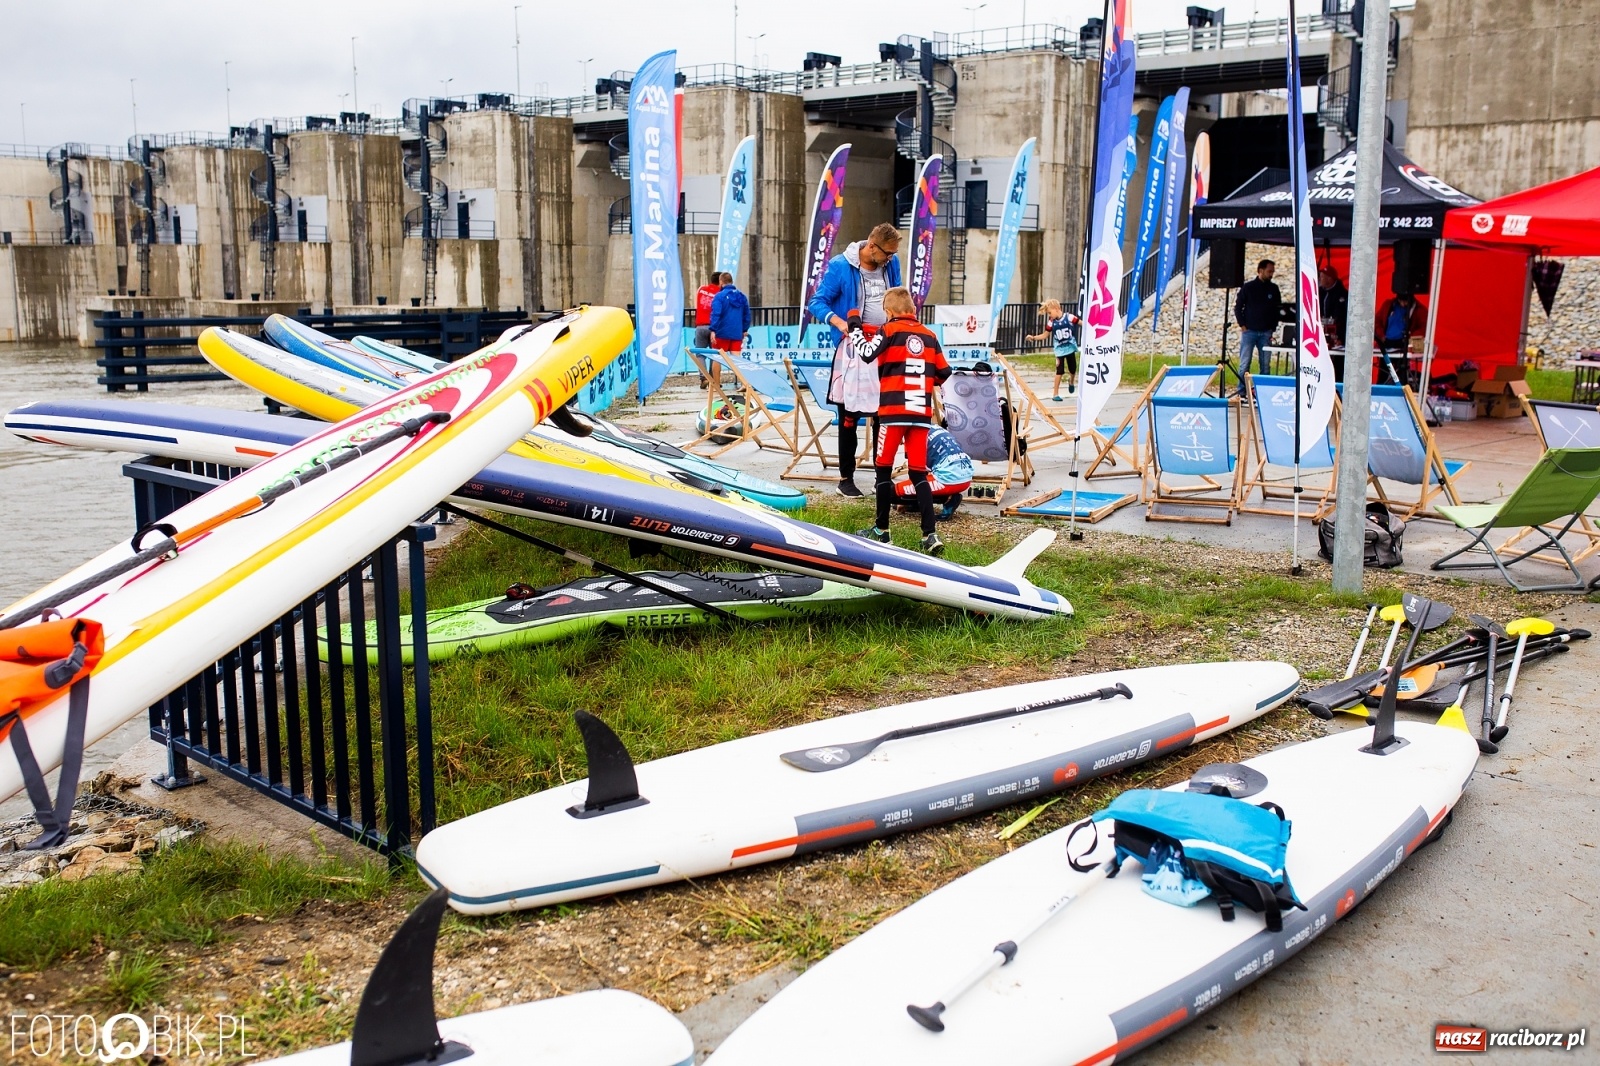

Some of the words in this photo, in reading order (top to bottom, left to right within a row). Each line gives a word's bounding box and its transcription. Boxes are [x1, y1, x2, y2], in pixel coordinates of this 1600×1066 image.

[635, 104, 651, 113] Aqua
[651, 106, 669, 115] Marina
[640, 127, 665, 260] Marina
[1164, 161, 1177, 239] Marina
[1142, 168, 1160, 241] Marina
[1200, 217, 1238, 229] IMPREZY
[1323, 216, 1336, 228] DJ
[1393, 216, 1412, 228] 342
[1414, 216, 1433, 228] 223
[646, 270, 675, 366] Aqua
[775, 332, 791, 343] OD
[817, 331, 832, 343] OD
[557, 355, 595, 394] VIPER
[904, 358, 926, 415] RTW
[591, 505, 608, 522] 14
[630, 516, 671, 532] ELITE
[671, 525, 725, 543] GLADIATOR
[626, 612, 691, 627] BREEZE
[1093, 747, 1138, 770] GLADIATOR
[1016, 785, 1040, 796] LENGTH
[954, 801, 974, 812] WIDTH
[884, 817, 913, 828] VOLUME
